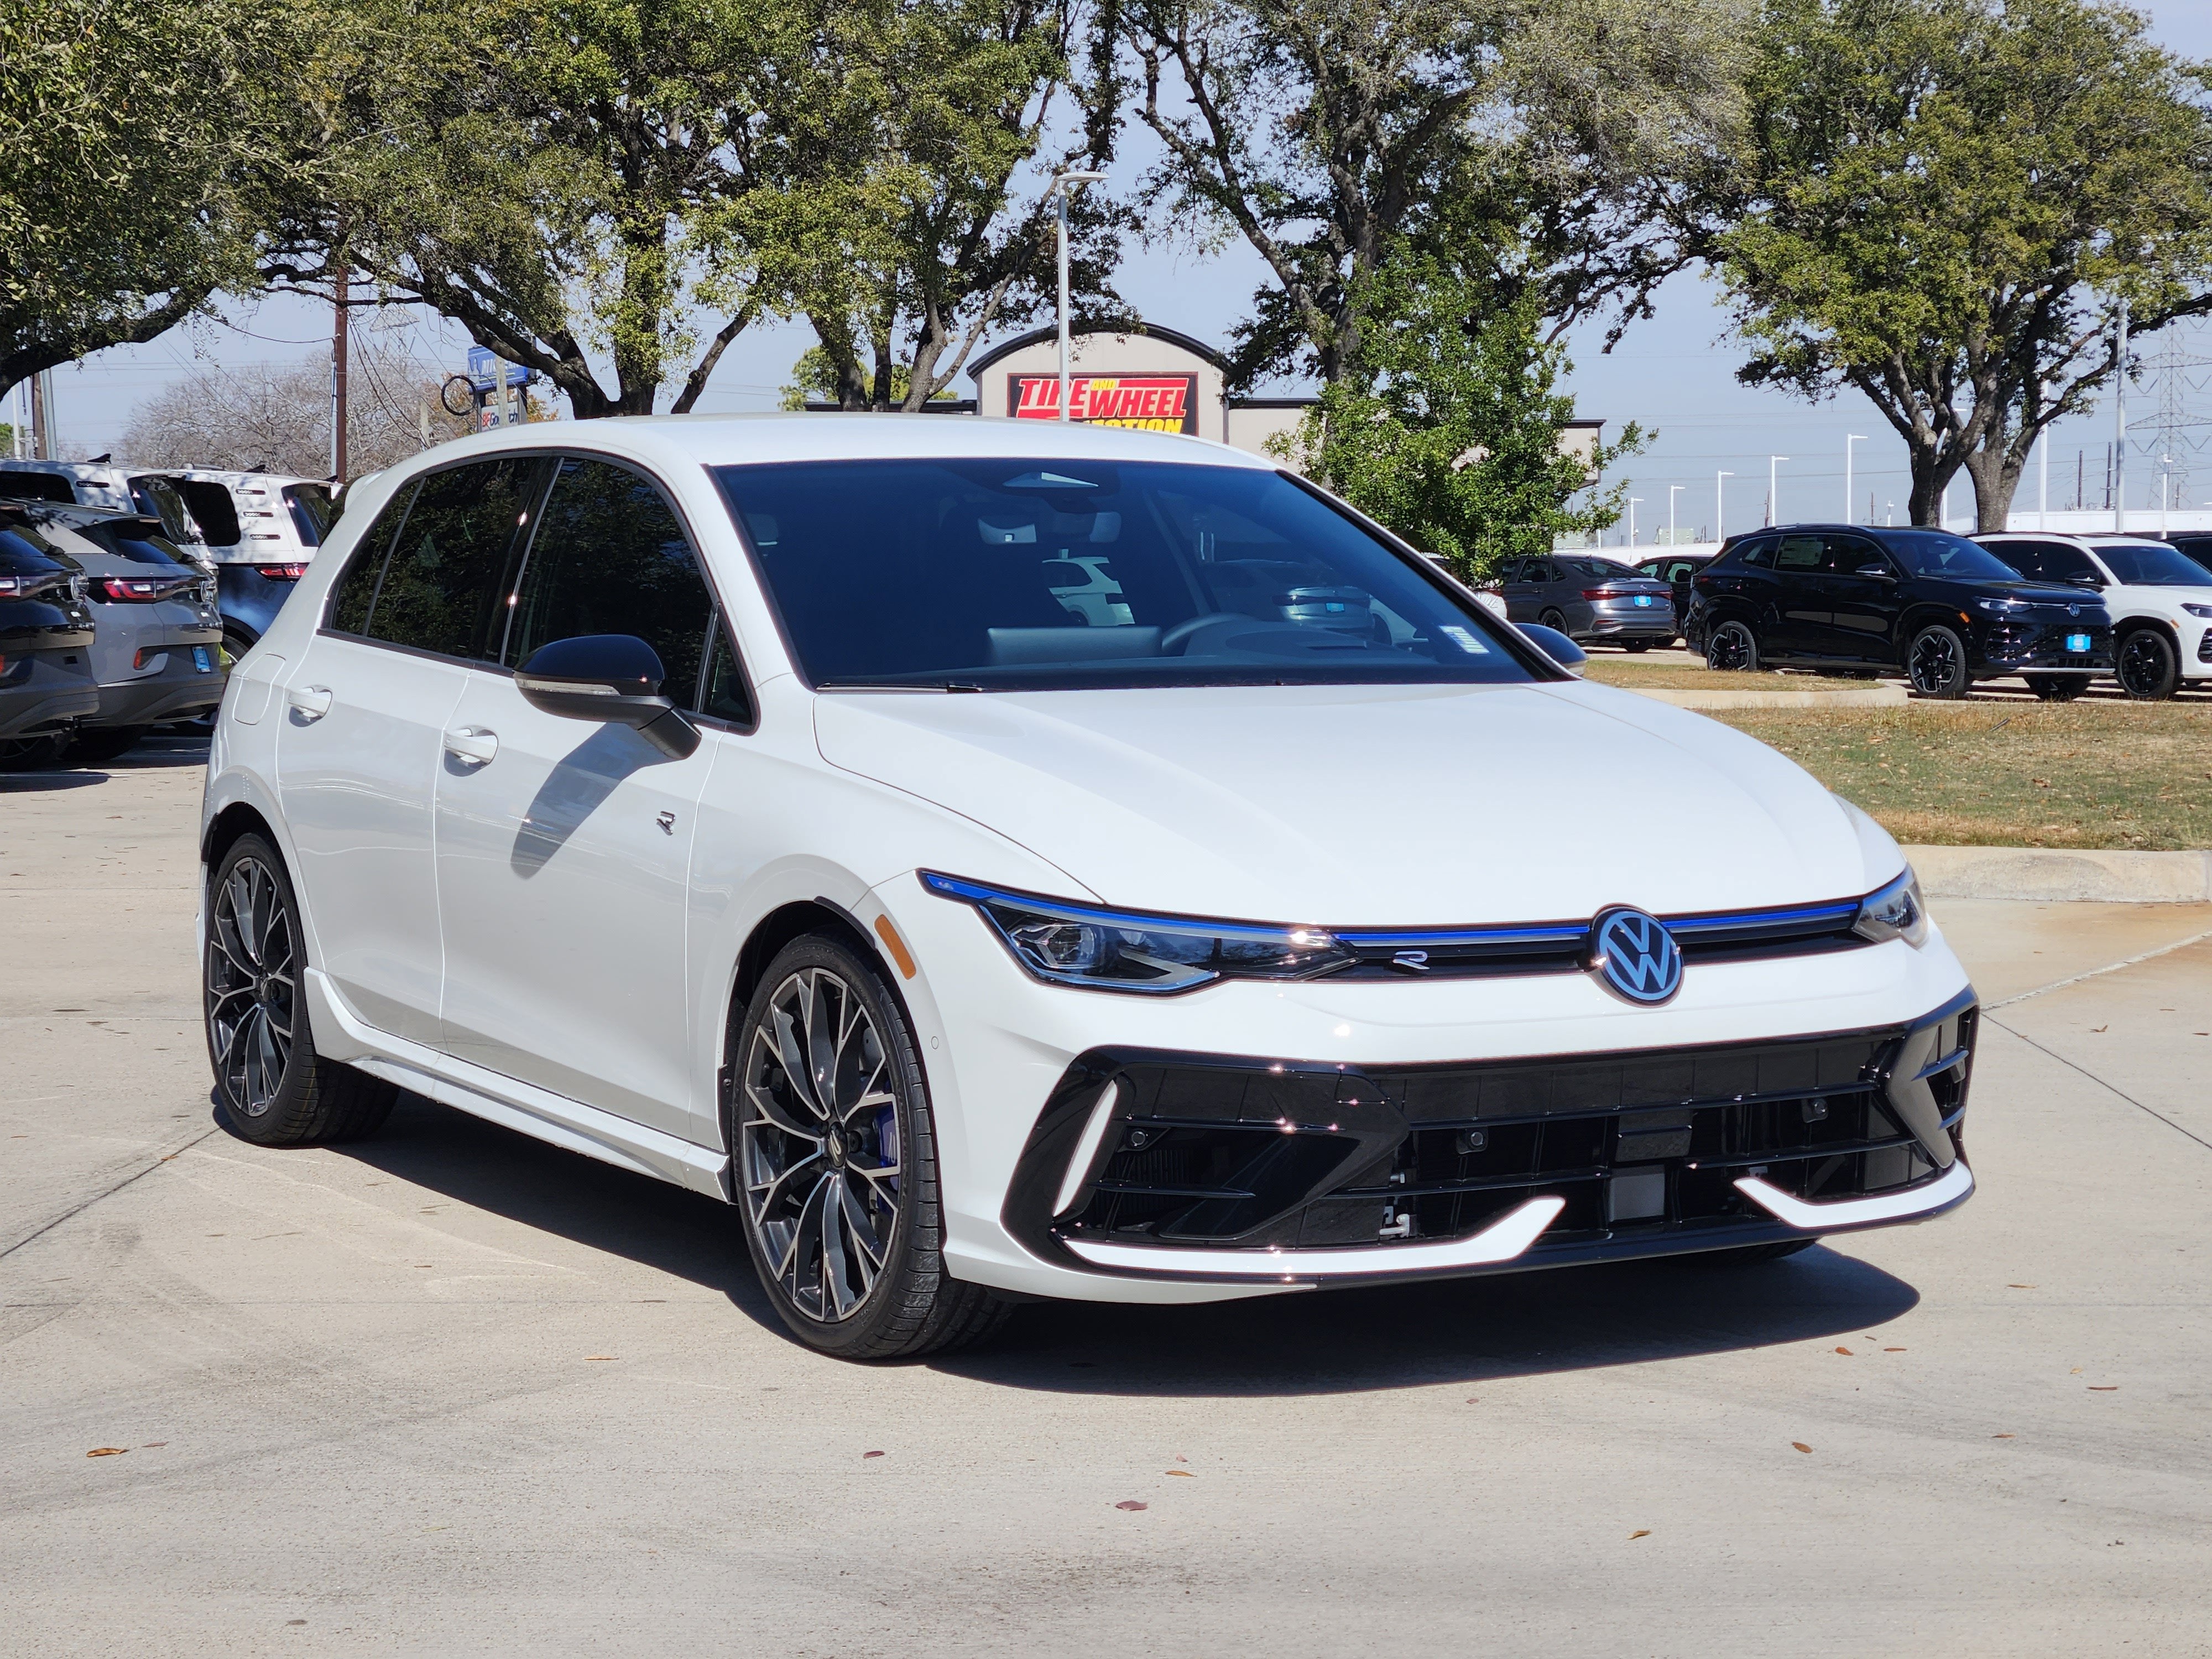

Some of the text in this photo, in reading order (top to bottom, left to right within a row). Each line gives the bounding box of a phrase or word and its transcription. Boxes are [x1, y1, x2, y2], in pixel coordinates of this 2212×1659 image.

[1091, 379, 1118, 390] AND
[1088, 388, 1188, 418] WHEEL
[482, 408, 518, 427] BFGoich
[1392, 951, 1430, 969] R
[1600, 912, 1679, 999] VW
